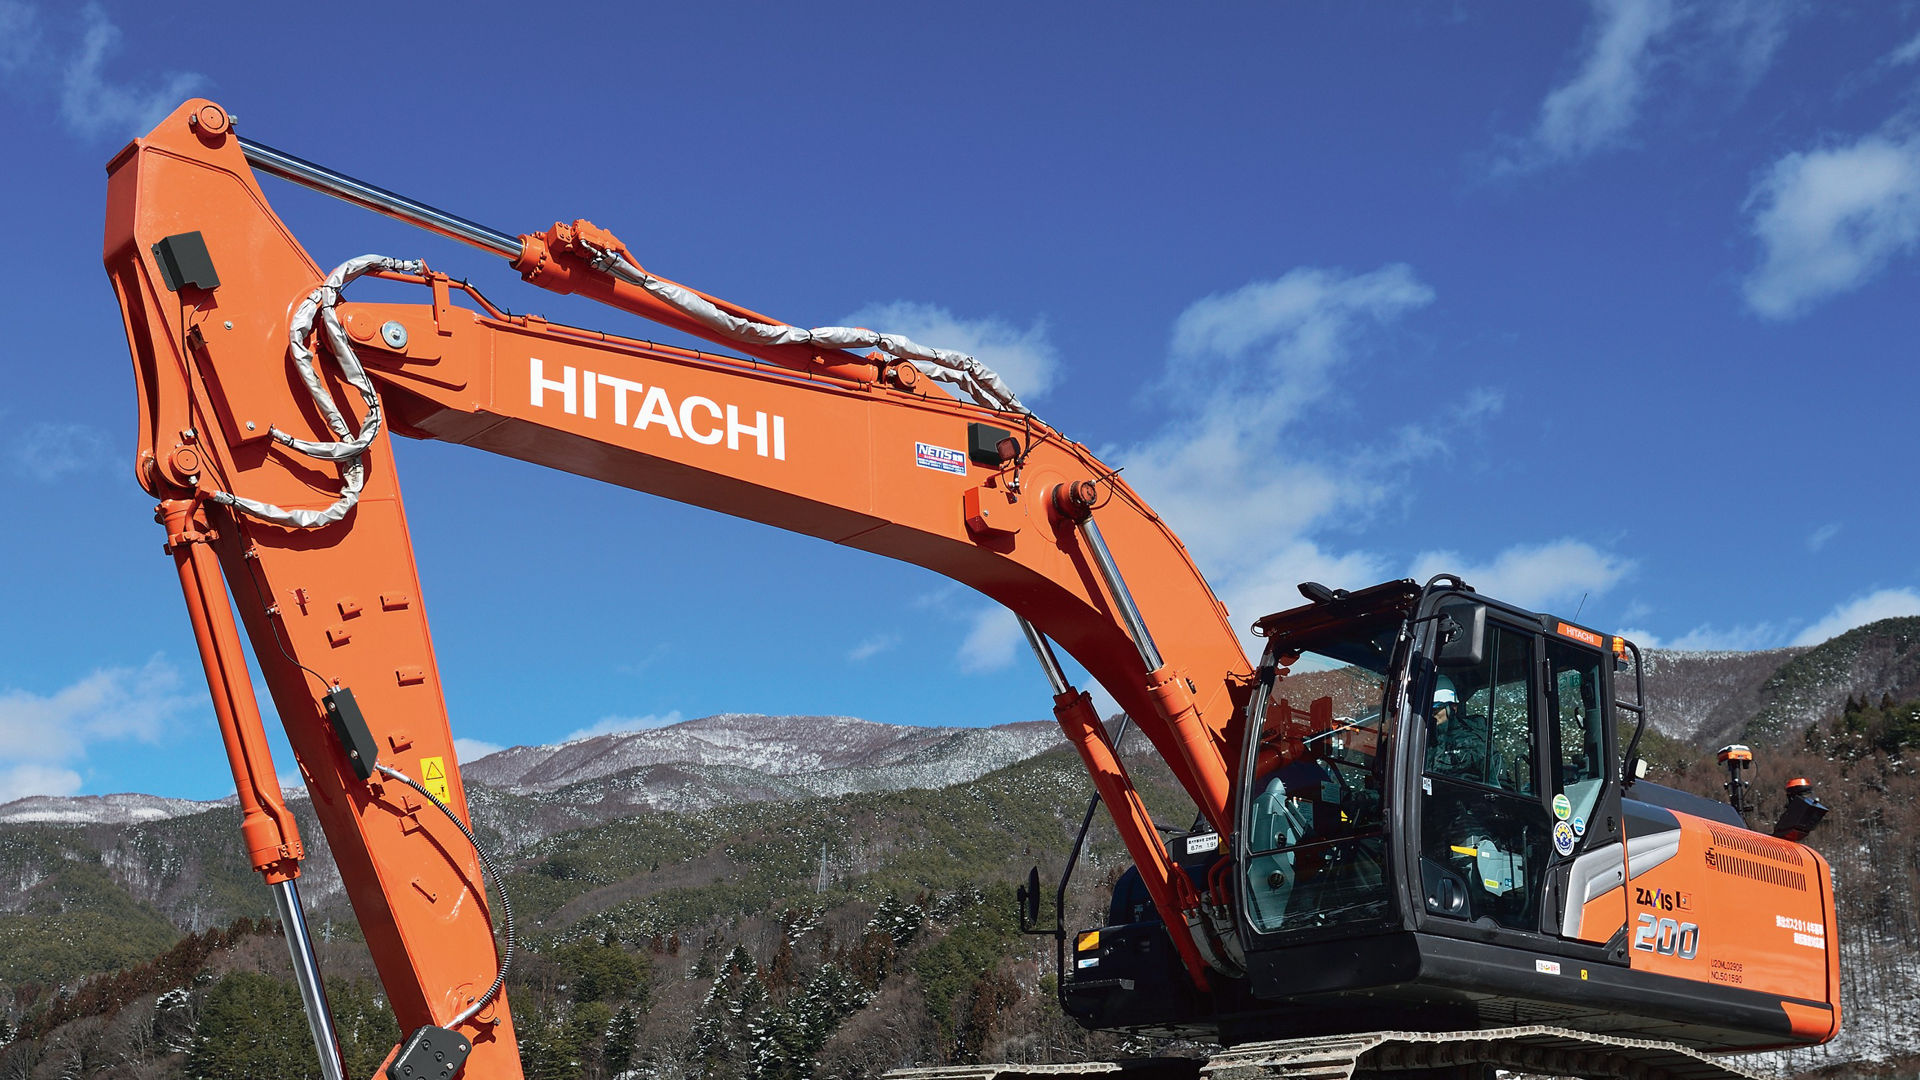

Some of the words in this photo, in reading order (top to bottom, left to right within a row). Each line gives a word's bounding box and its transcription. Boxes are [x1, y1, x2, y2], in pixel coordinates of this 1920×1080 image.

[530, 357, 786, 461] HITACHI
[918, 444, 952, 460] NETIS
[1566, 627, 1594, 643] HITACHI
[1636, 887, 1673, 911] ZAXIS
[1634, 912, 1699, 960] 200
